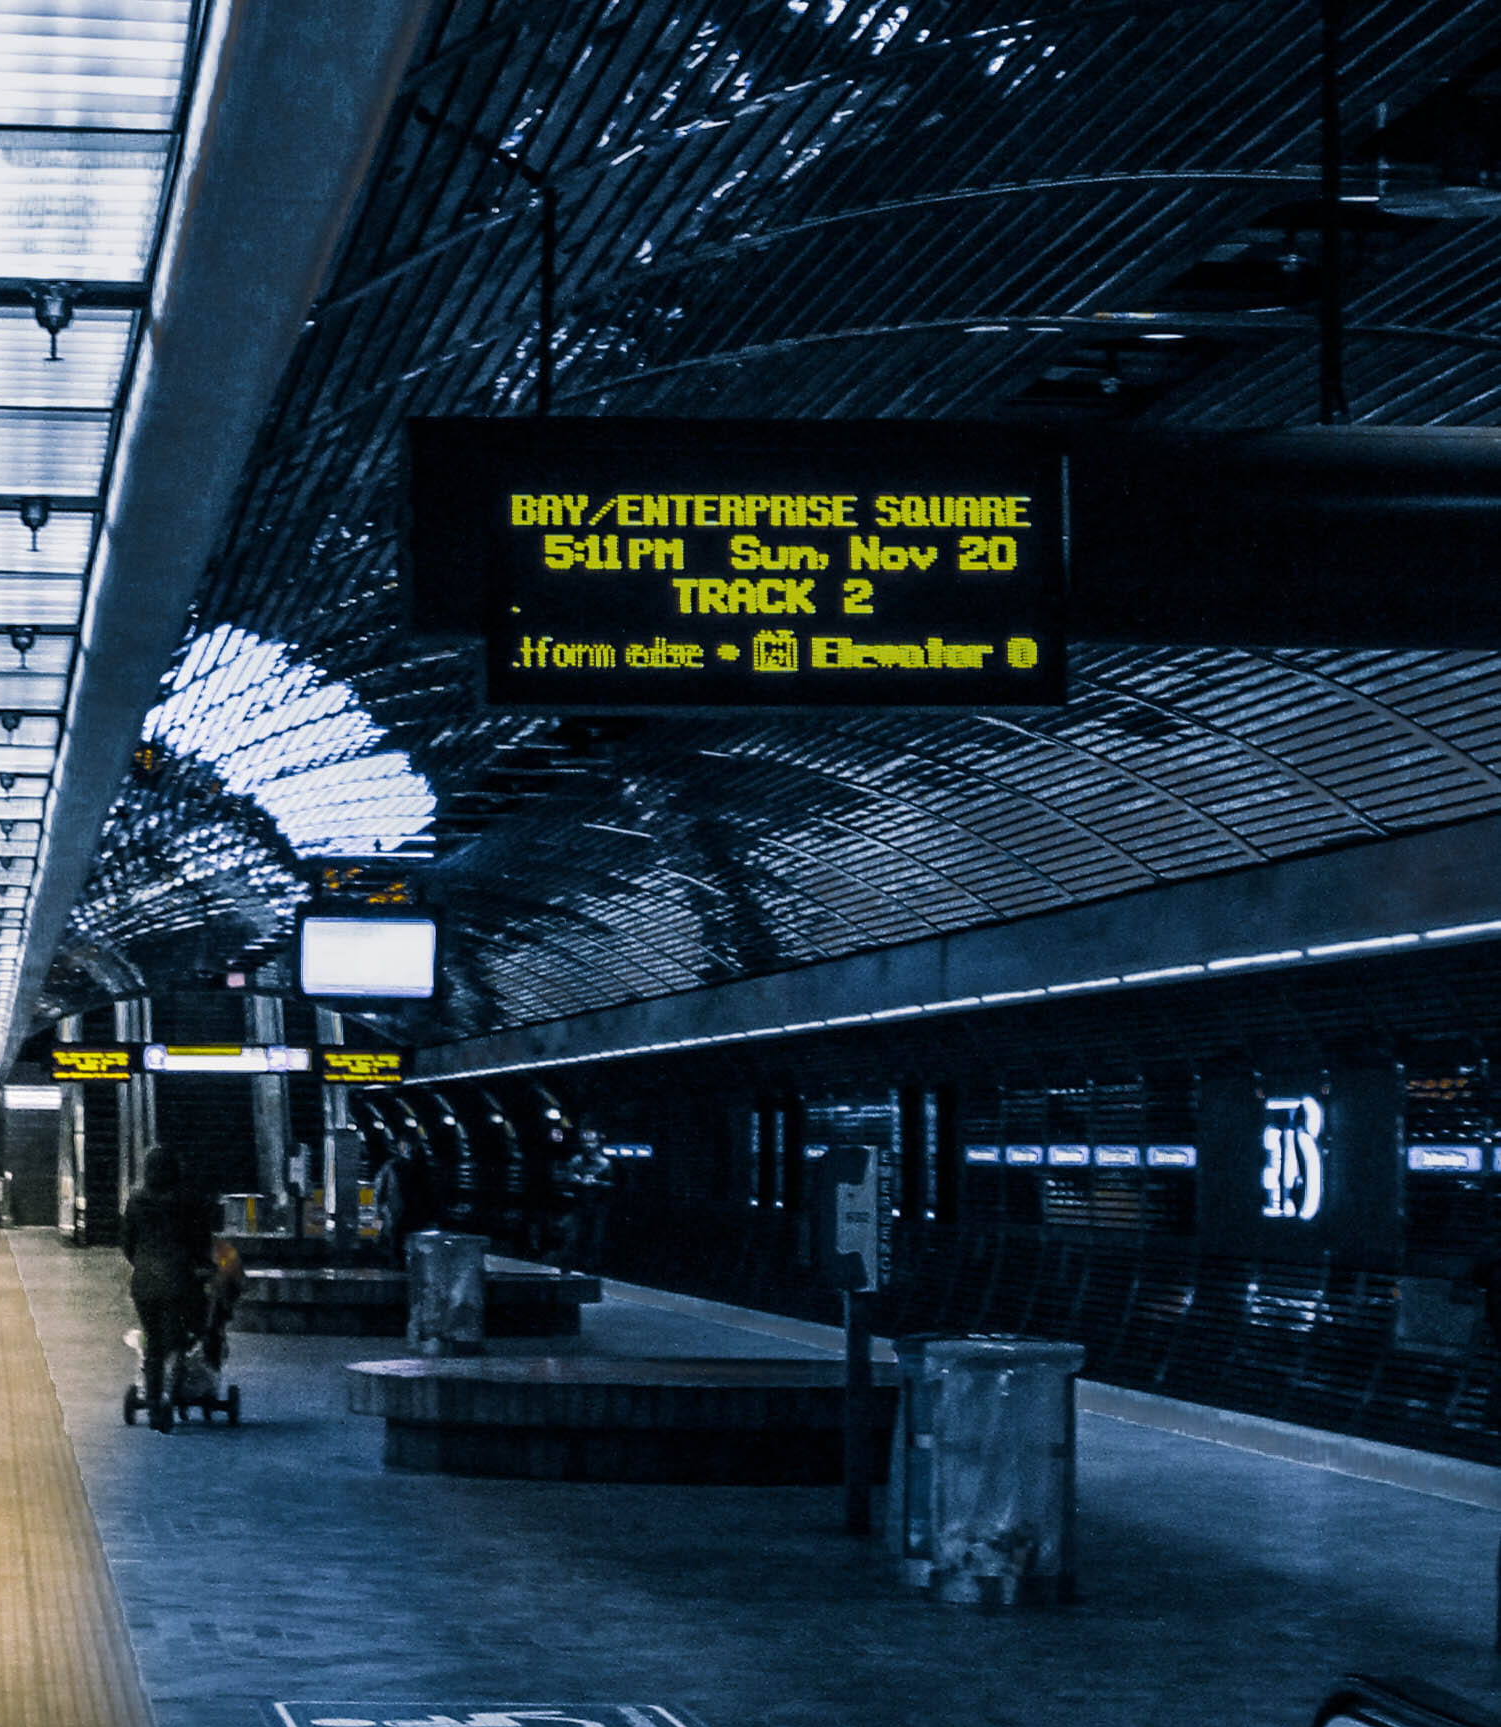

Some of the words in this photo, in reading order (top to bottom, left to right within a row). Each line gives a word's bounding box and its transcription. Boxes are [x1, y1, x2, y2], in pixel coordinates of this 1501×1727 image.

[511, 494, 859, 526] BAY/ENTERPRISE
[874, 495, 1030, 527] SQUARE
[730, 534, 830, 570] Sun,
[849, 535, 938, 571] Nov
[958, 535, 1018, 571] 20
[672, 578, 817, 614] TRACK
[843, 578, 874, 614] 2
